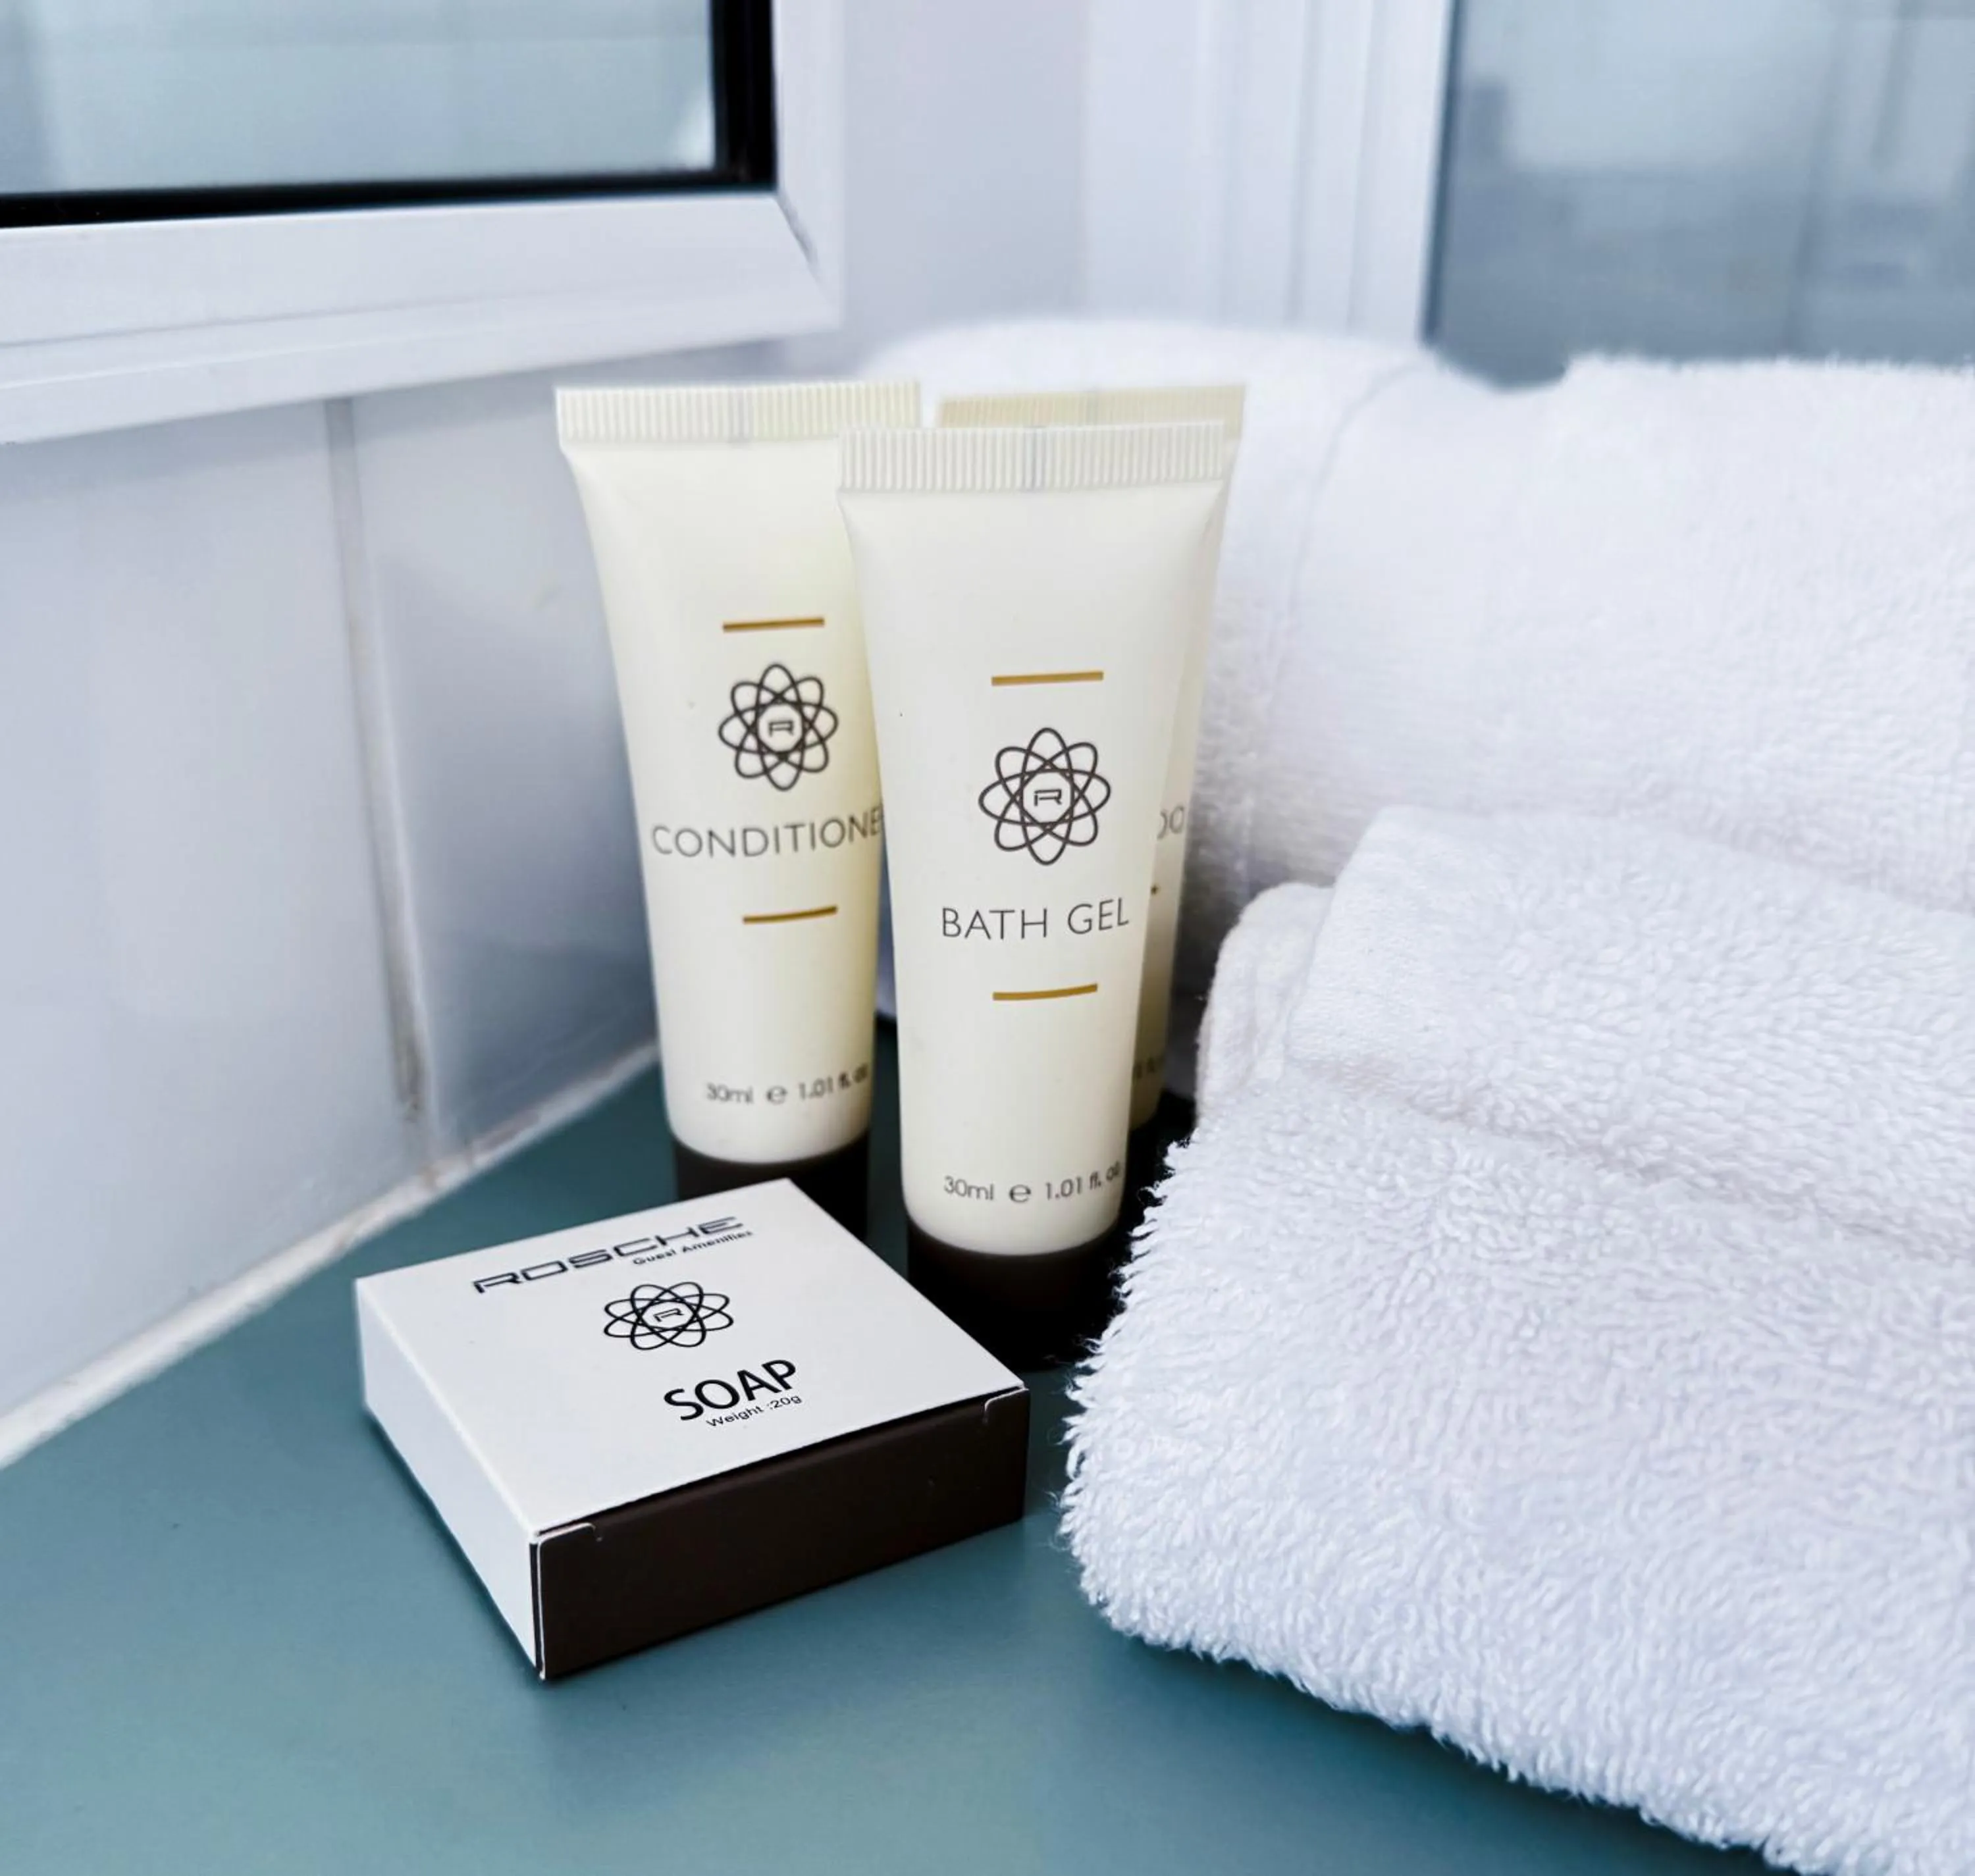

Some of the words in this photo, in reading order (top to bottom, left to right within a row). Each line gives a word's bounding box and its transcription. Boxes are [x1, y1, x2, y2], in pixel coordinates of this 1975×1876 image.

[1033, 788, 1063, 807] R
[651, 805, 883, 858] CONDITIONE
[941, 906, 1048, 940] BATH
[1067, 897, 1130, 935] GEL
[706, 1082, 754, 1105] 30ml
[943, 1176, 995, 1201] 30ml
[1045, 1176, 1082, 1201] 1.01
[473, 1216, 744, 1295] ROSCHE
[632, 1249, 677, 1266] Guest
[683, 1230, 753, 1254] Amenities
[653, 1307, 685, 1322] R
[663, 1359, 797, 1421] SOAP
[706, 1404, 764, 1427] Weight
